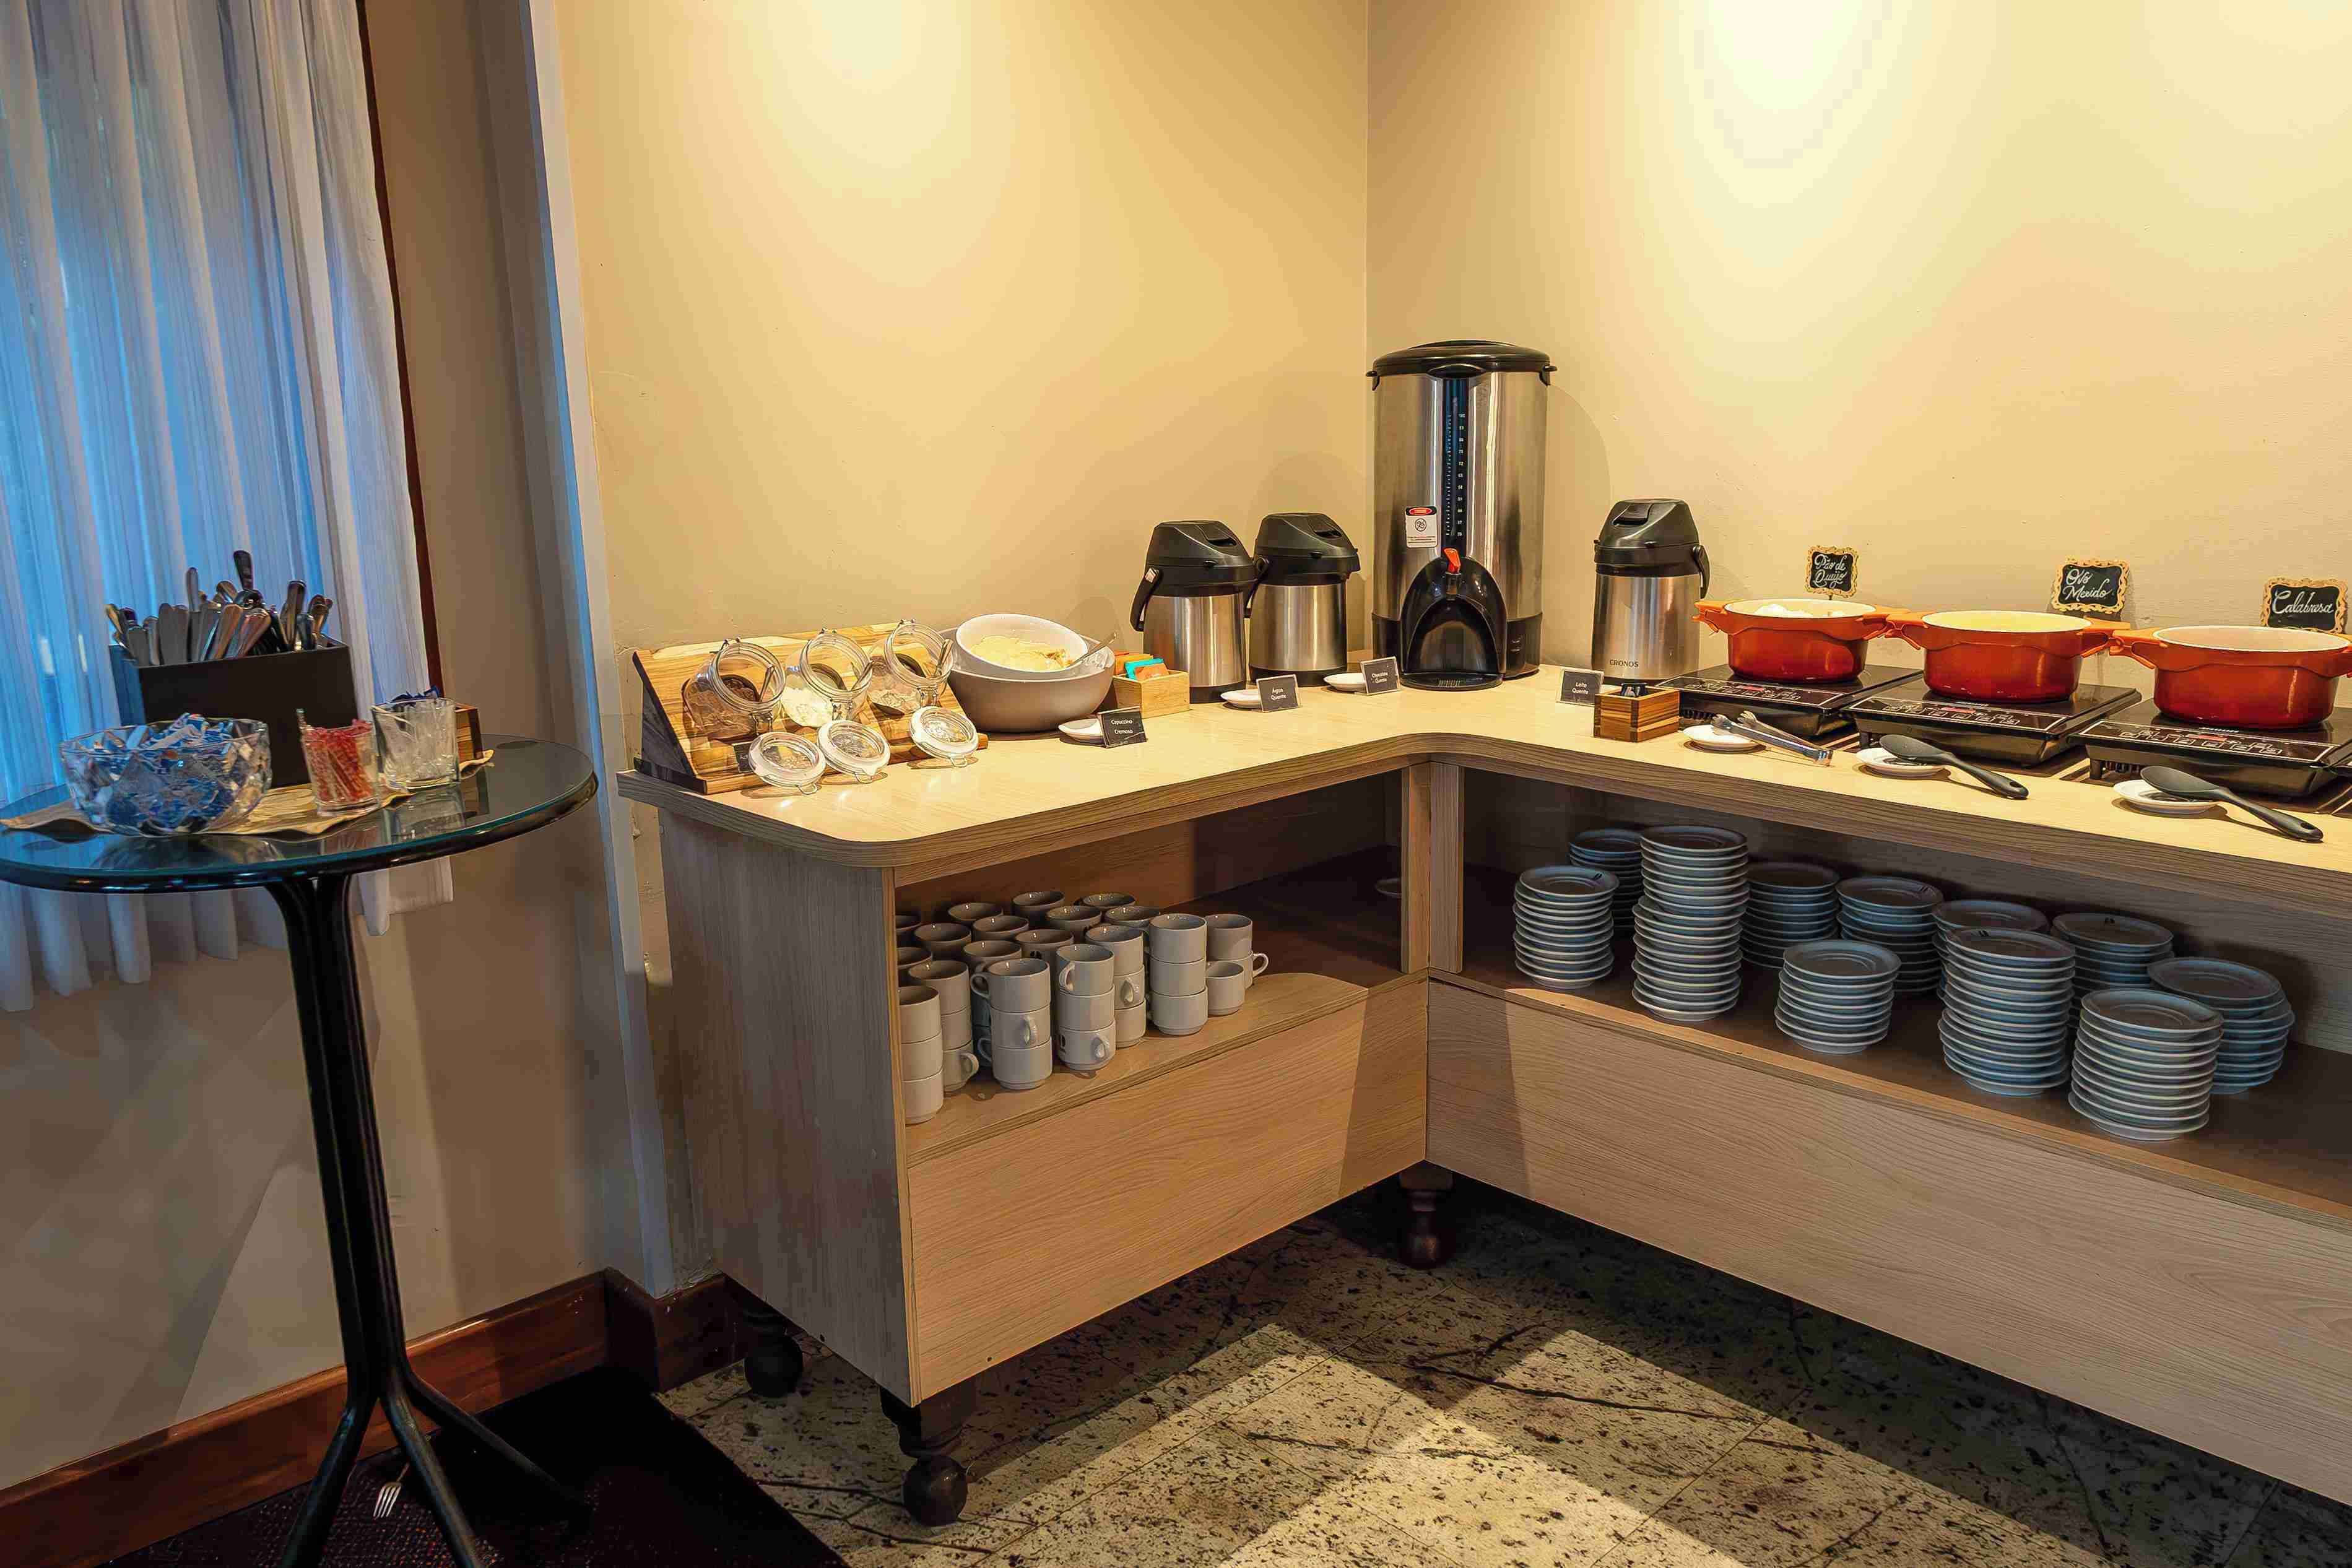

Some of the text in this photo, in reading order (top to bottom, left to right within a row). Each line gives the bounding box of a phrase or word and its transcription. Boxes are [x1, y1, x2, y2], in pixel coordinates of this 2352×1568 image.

[1835, 555, 1847, 571] de
[2066, 568, 2093, 585] Ovo
[2272, 589, 2334, 614] Calabresa
[1609, 659, 1639, 668] CRONOS
